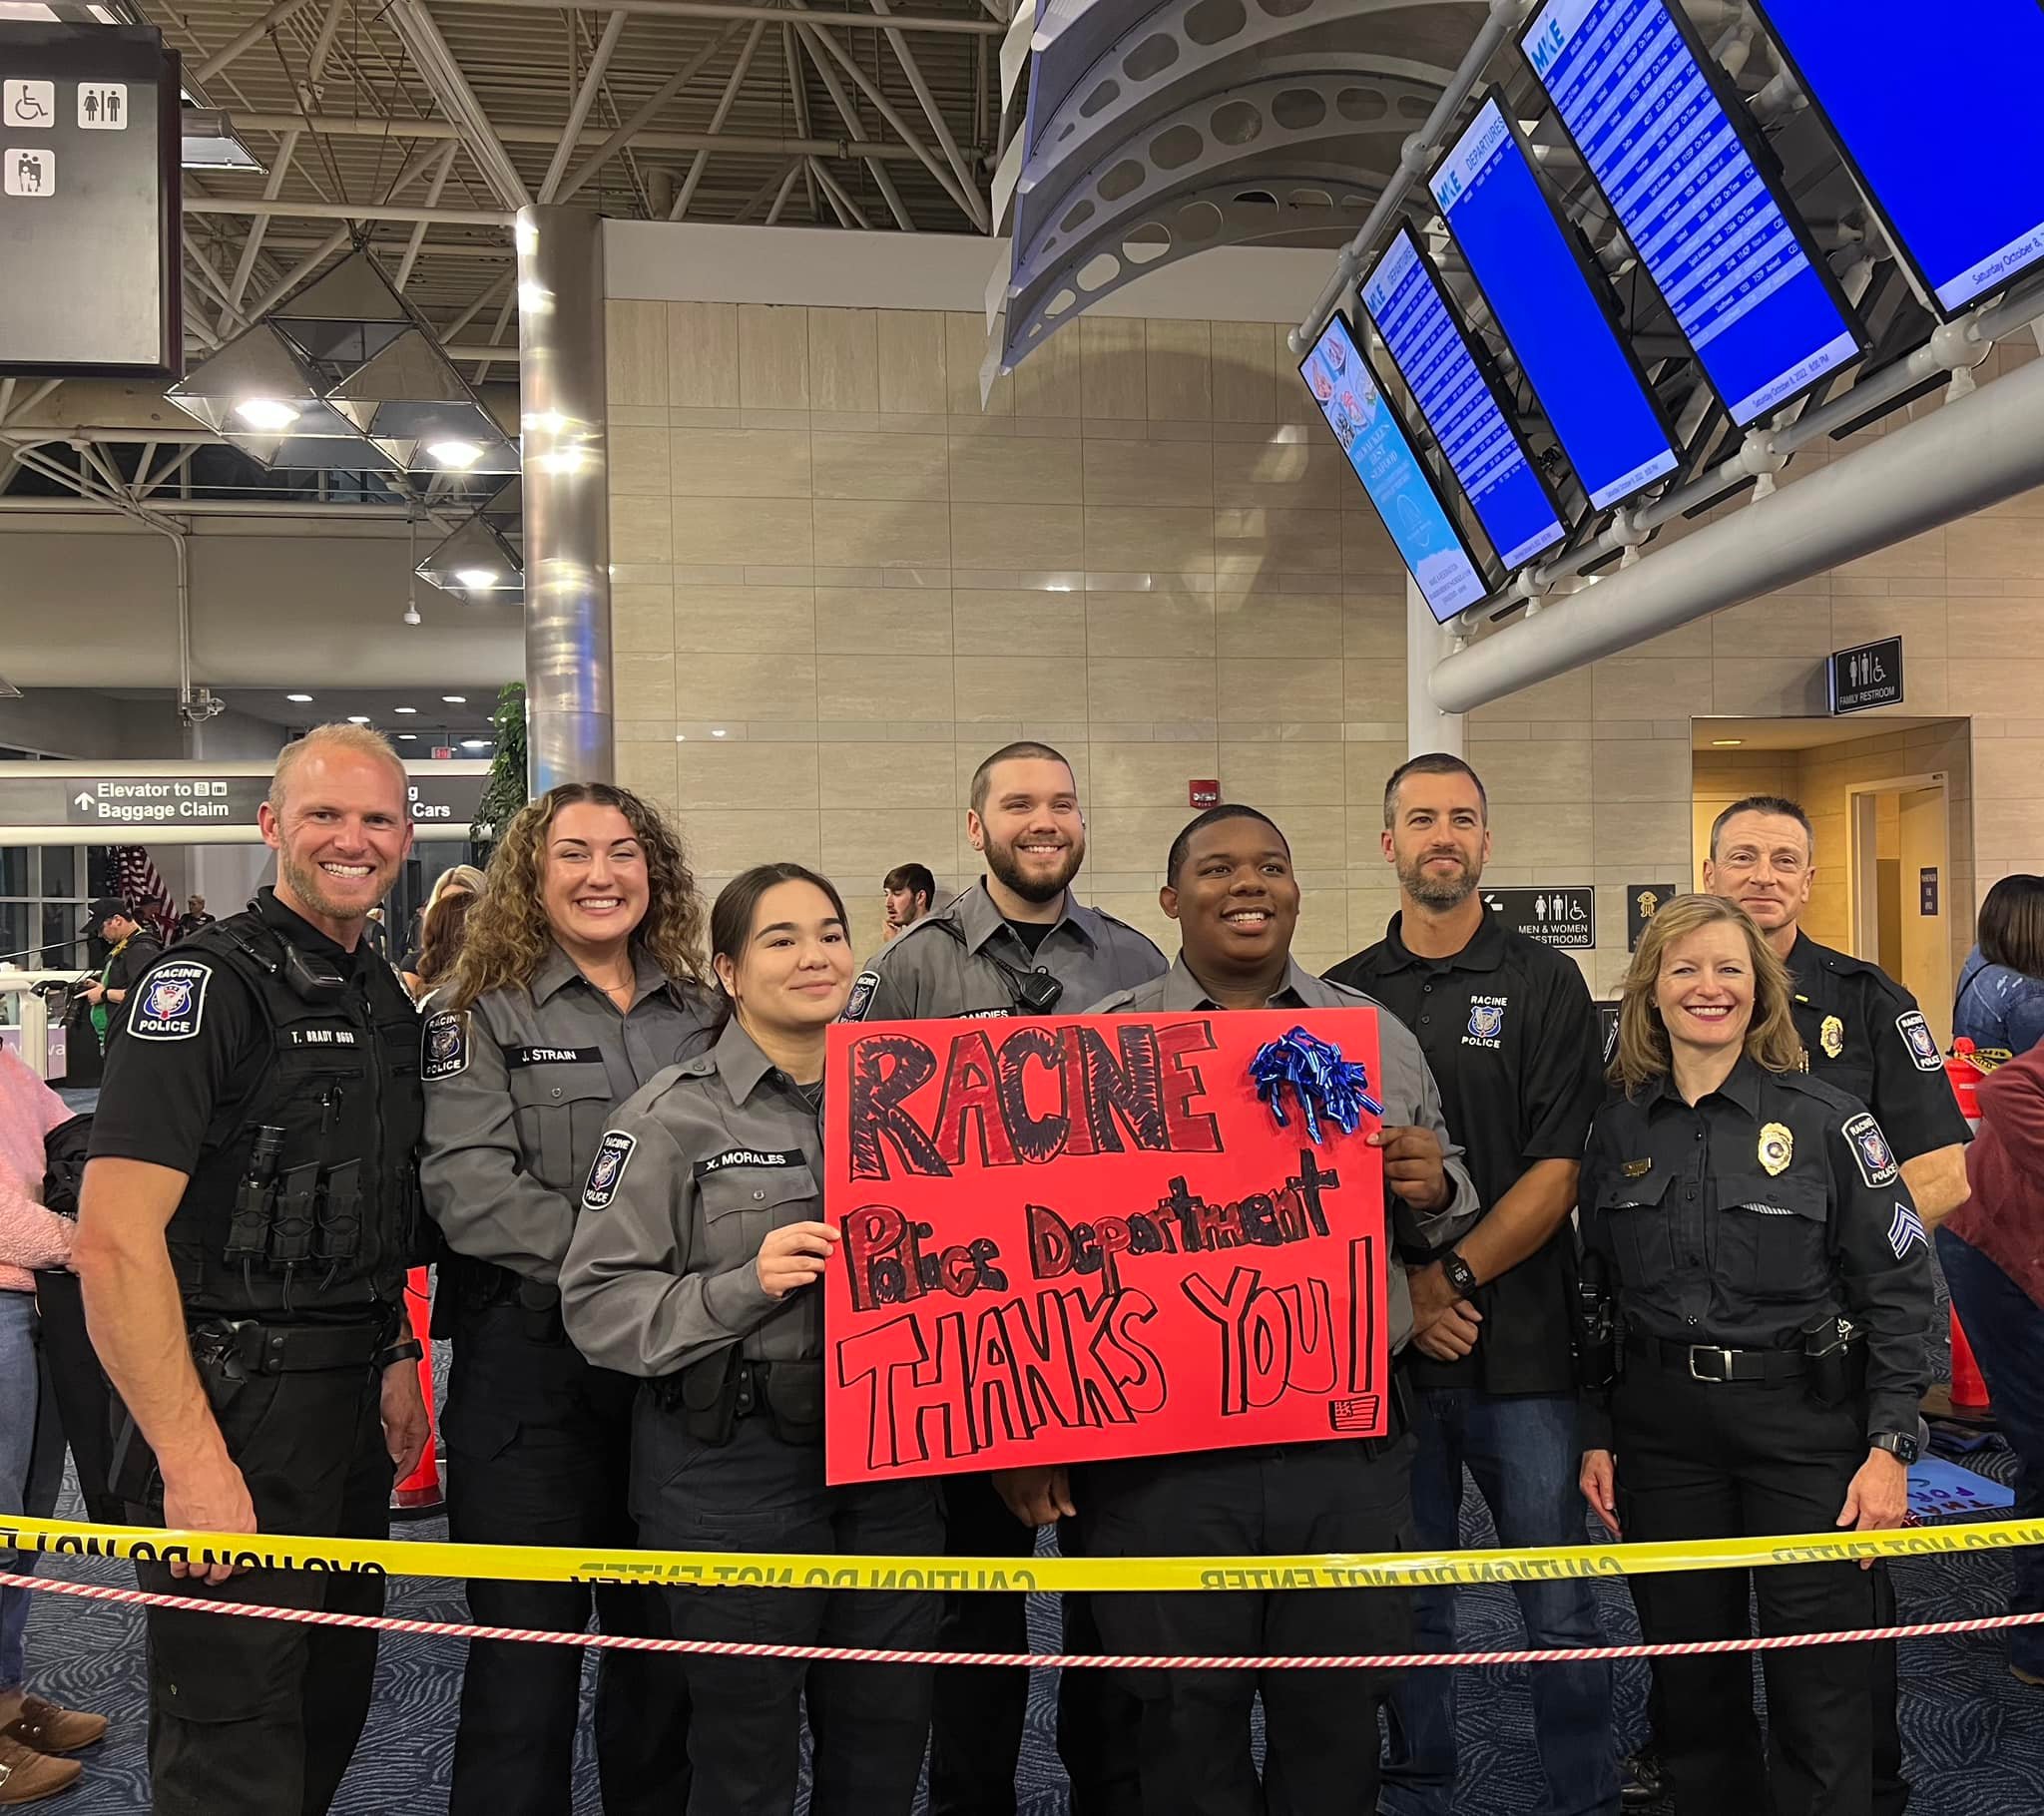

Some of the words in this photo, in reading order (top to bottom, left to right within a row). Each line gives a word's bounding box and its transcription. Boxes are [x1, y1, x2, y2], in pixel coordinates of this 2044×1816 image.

[1531, 18, 1565, 75] MKE
[1437, 170, 1462, 211] MKE
[1465, 117, 1506, 172] DEPARTURES
[1972, 261, 2005, 284] Saturday
[2002, 243, 2033, 265] October
[1839, 693, 1858, 705] FAMILY
[1859, 685, 1895, 701] RESTROOM
[97, 782, 170, 797] Elevator
[174, 781, 192, 796] to
[98, 802, 176, 821] Baggage
[180, 801, 229, 816] Claim
[412, 802, 451, 817] Cars
[1518, 925, 1540, 934] MEN
[1542, 924, 1548, 933] &
[1550, 924, 1588, 933] WOMEN
[1529, 934, 1589, 944] ESTROOMS
[154, 968, 203, 980] RACINE
[1470, 996, 1508, 1007] RACINE
[139, 1020, 191, 1033] POLICE
[429, 1014, 463, 1030] RACIN
[290, 1031, 302, 1044] T.
[305, 1030, 332, 1043] BRADY
[1461, 1036, 1501, 1049] POLICE
[521, 1051, 530, 1063] J.
[532, 1050, 577, 1062] STRAIN
[1919, 1055, 1941, 1069] POLICE
[426, 1059, 461, 1075] POLICE
[849, 1019, 1224, 1183] RACINE
[1848, 1117, 1875, 1136] RACINE
[605, 1136, 631, 1150] RACINE
[706, 1158, 720, 1170] X.
[722, 1151, 786, 1165] MORALES
[1871, 1163, 1897, 1183] POLICE
[586, 1188, 610, 1203] POLICE
[840, 1204, 1008, 1312] Police
[1025, 1148, 1340, 1295] Department
[836, 1287, 1168, 1470] THANKS
[1181, 1235, 1373, 1416] YOU!
